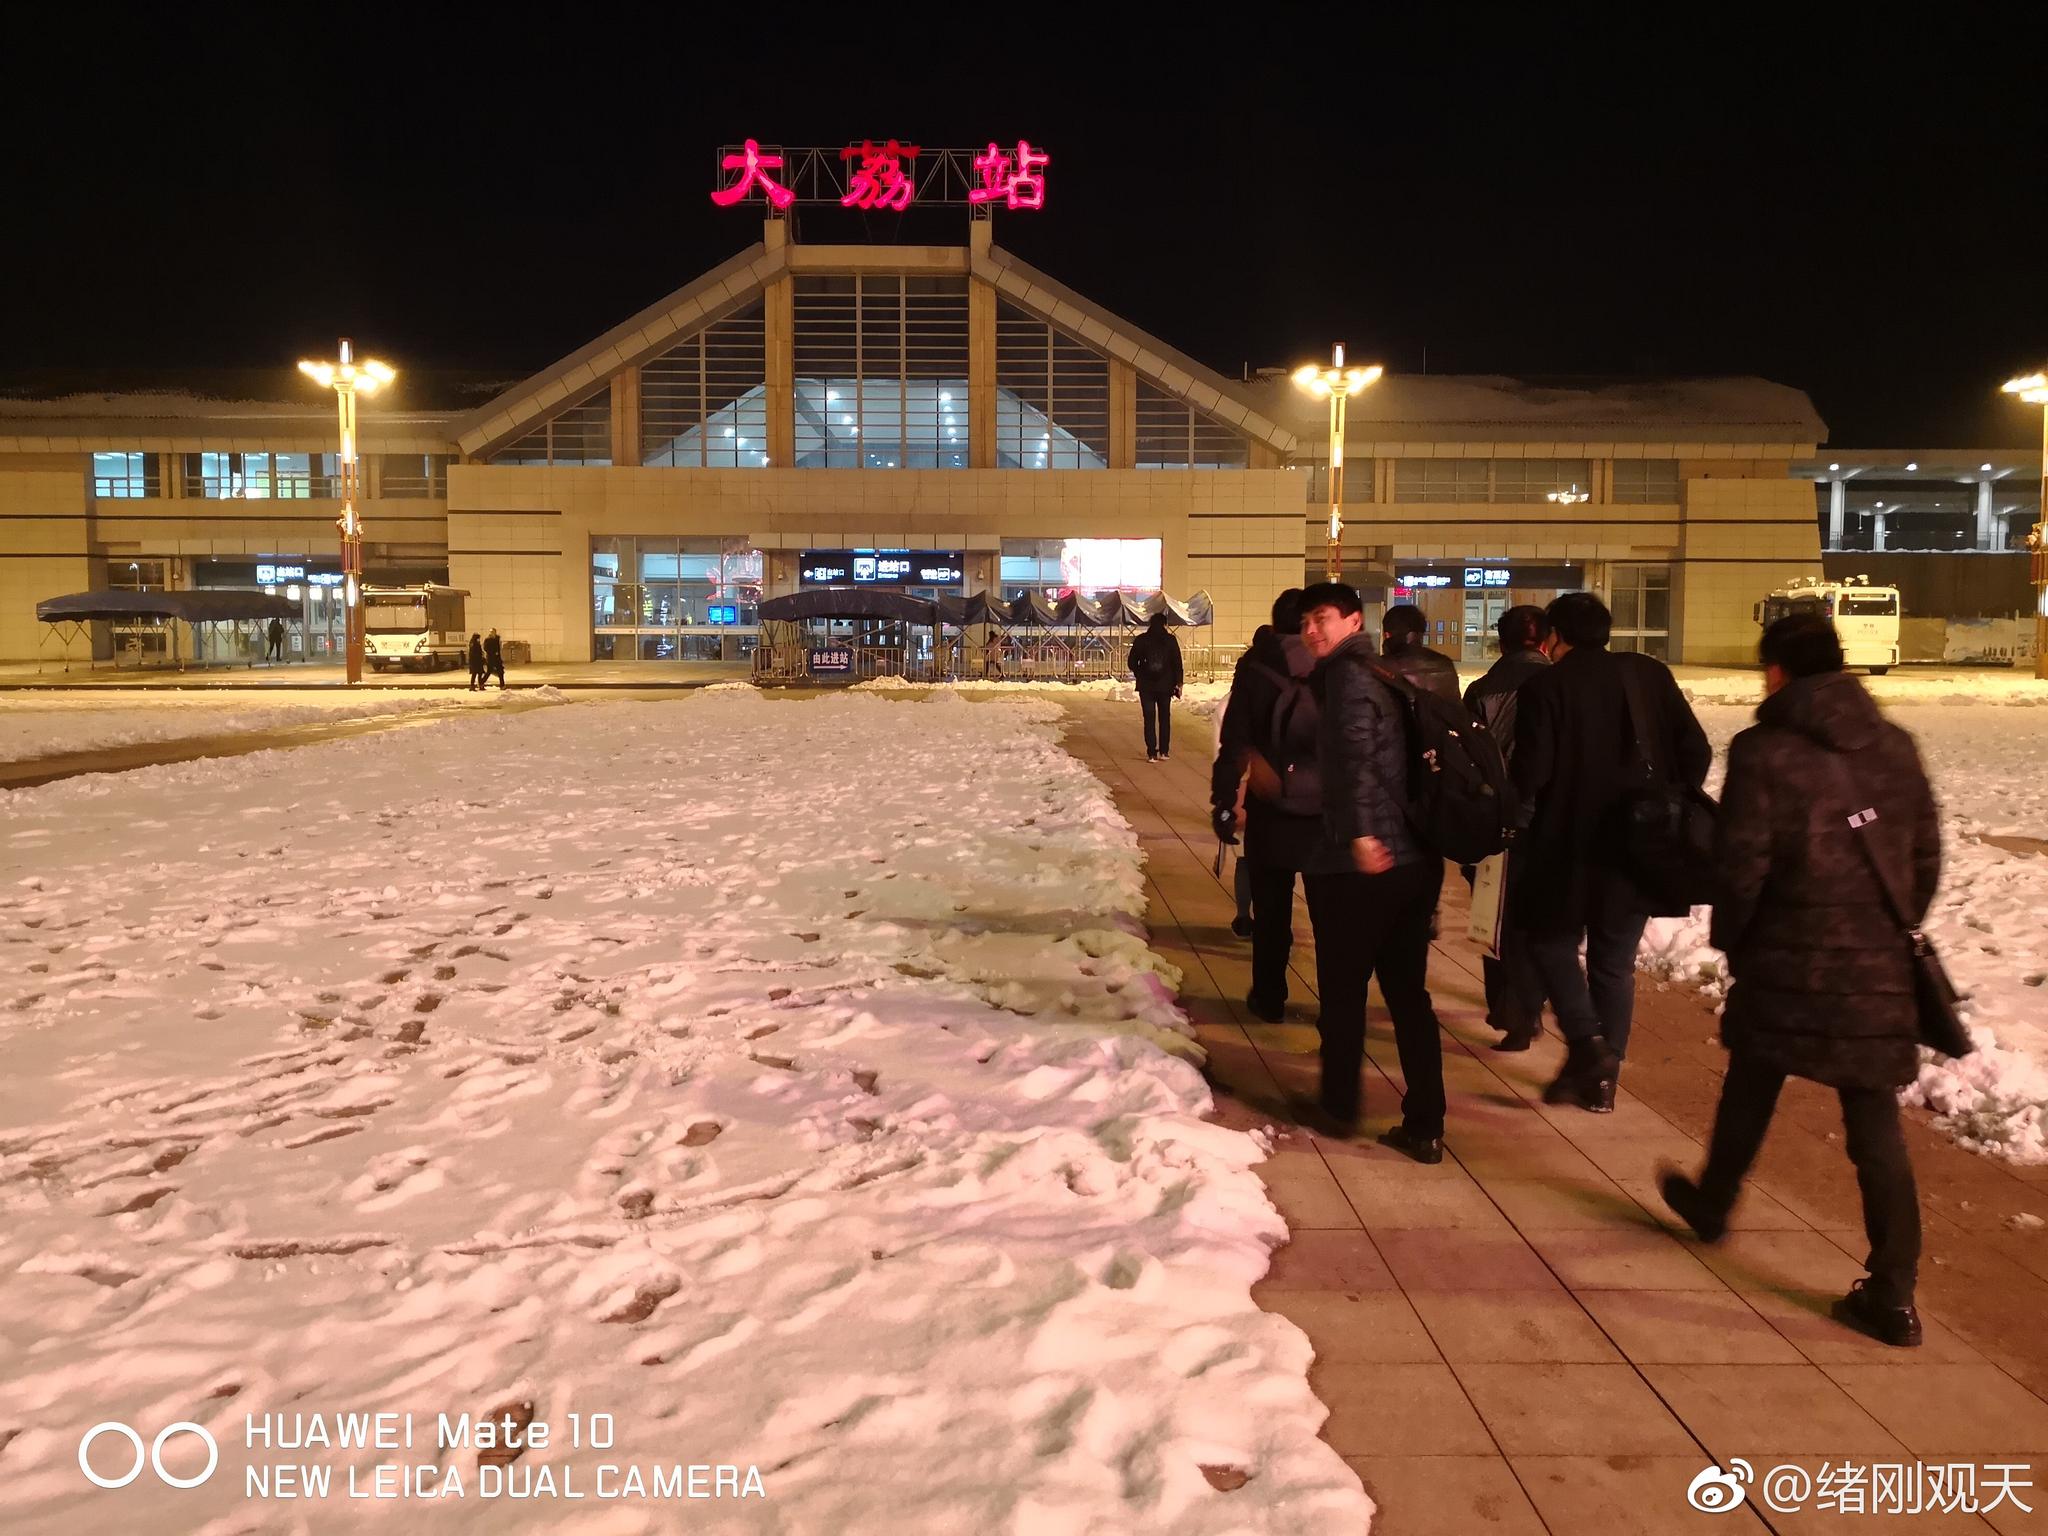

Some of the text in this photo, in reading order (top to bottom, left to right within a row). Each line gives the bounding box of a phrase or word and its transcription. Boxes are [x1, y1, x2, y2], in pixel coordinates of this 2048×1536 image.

[711, 138, 1050, 211] 大荔站
[813, 651, 849, 664] 由此进站
